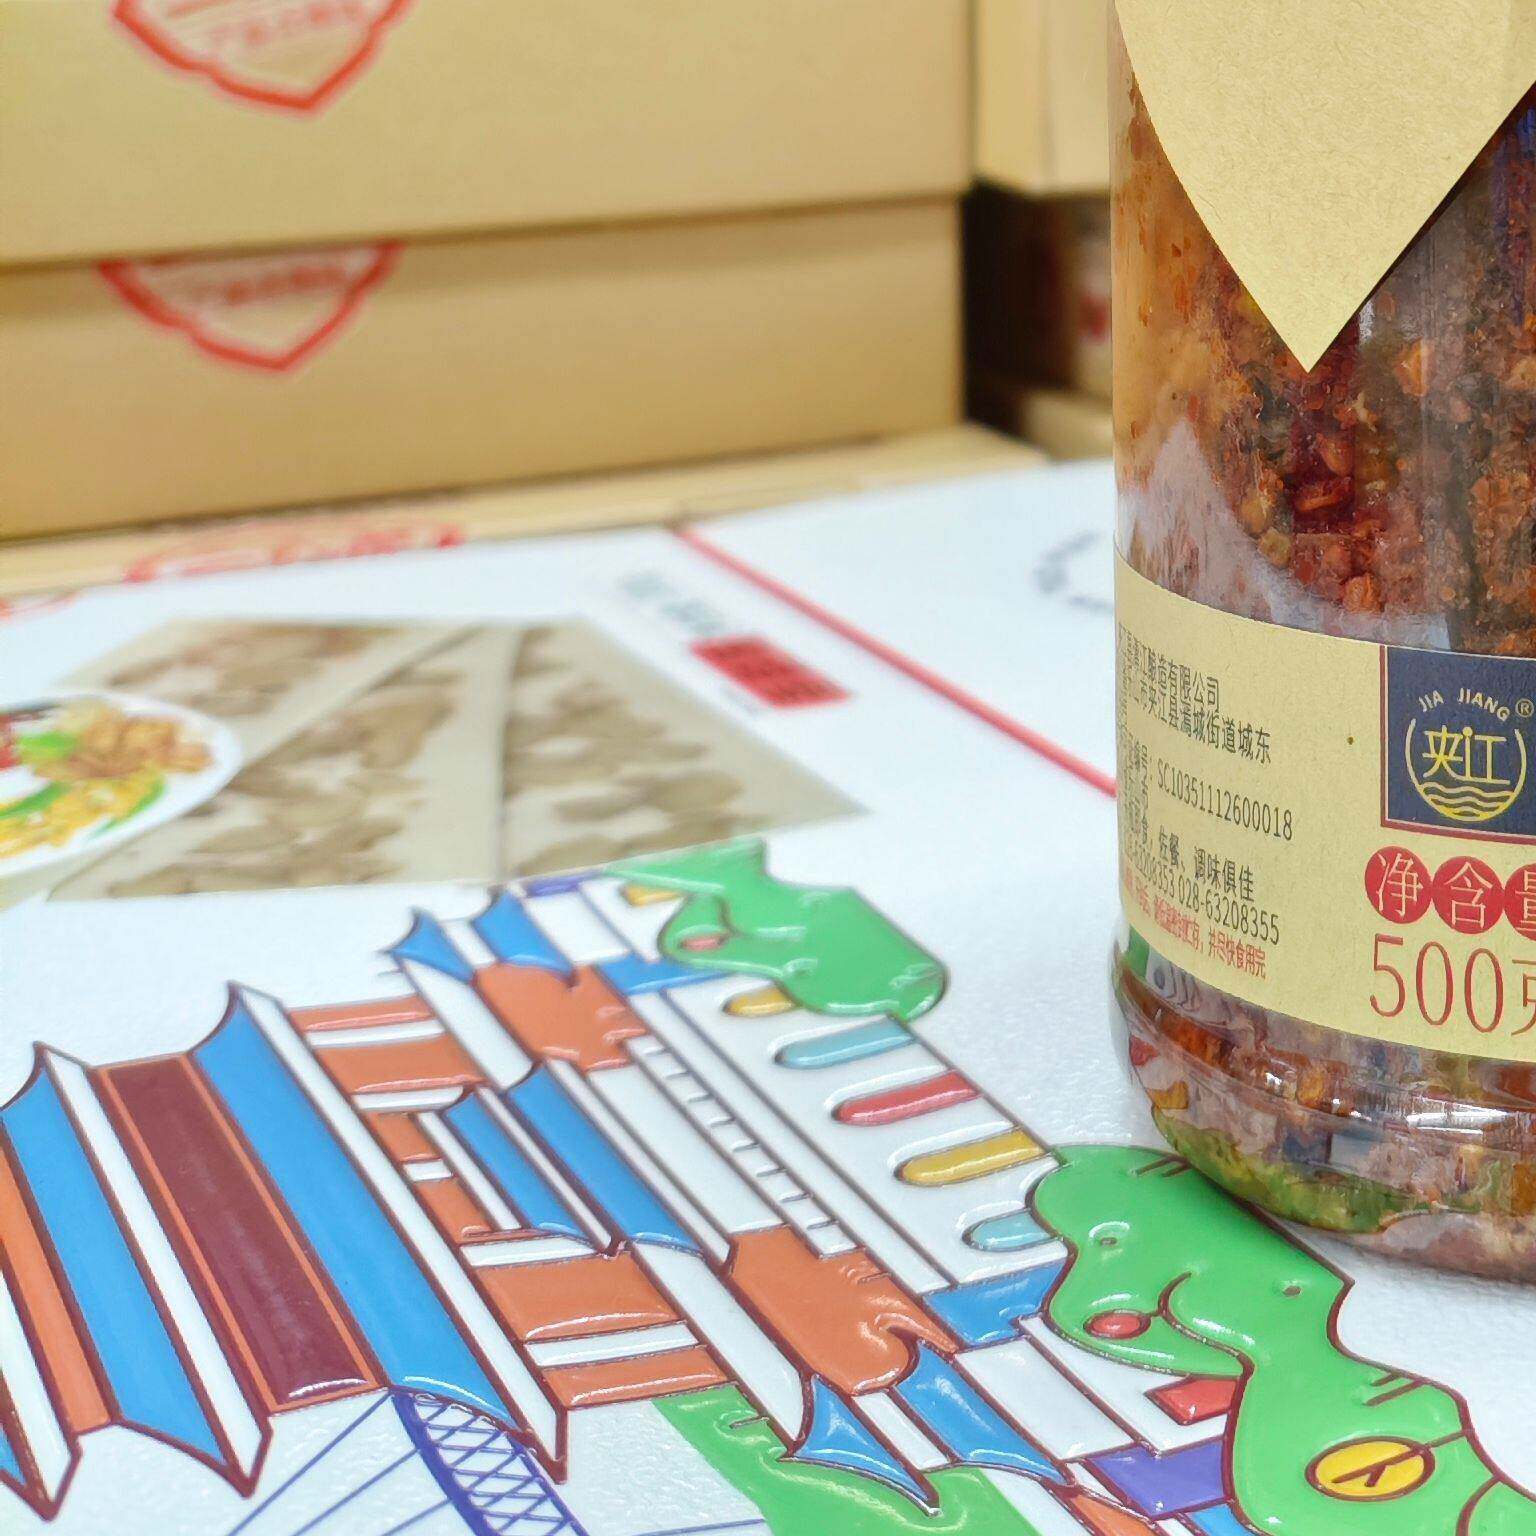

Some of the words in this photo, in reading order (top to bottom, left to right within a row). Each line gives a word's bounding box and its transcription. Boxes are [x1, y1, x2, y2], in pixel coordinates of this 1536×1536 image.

[1418, 690, 1444, 713] JIA
[1457, 687, 1511, 722] JIANG
[1422, 724, 1511, 785] 夹江
